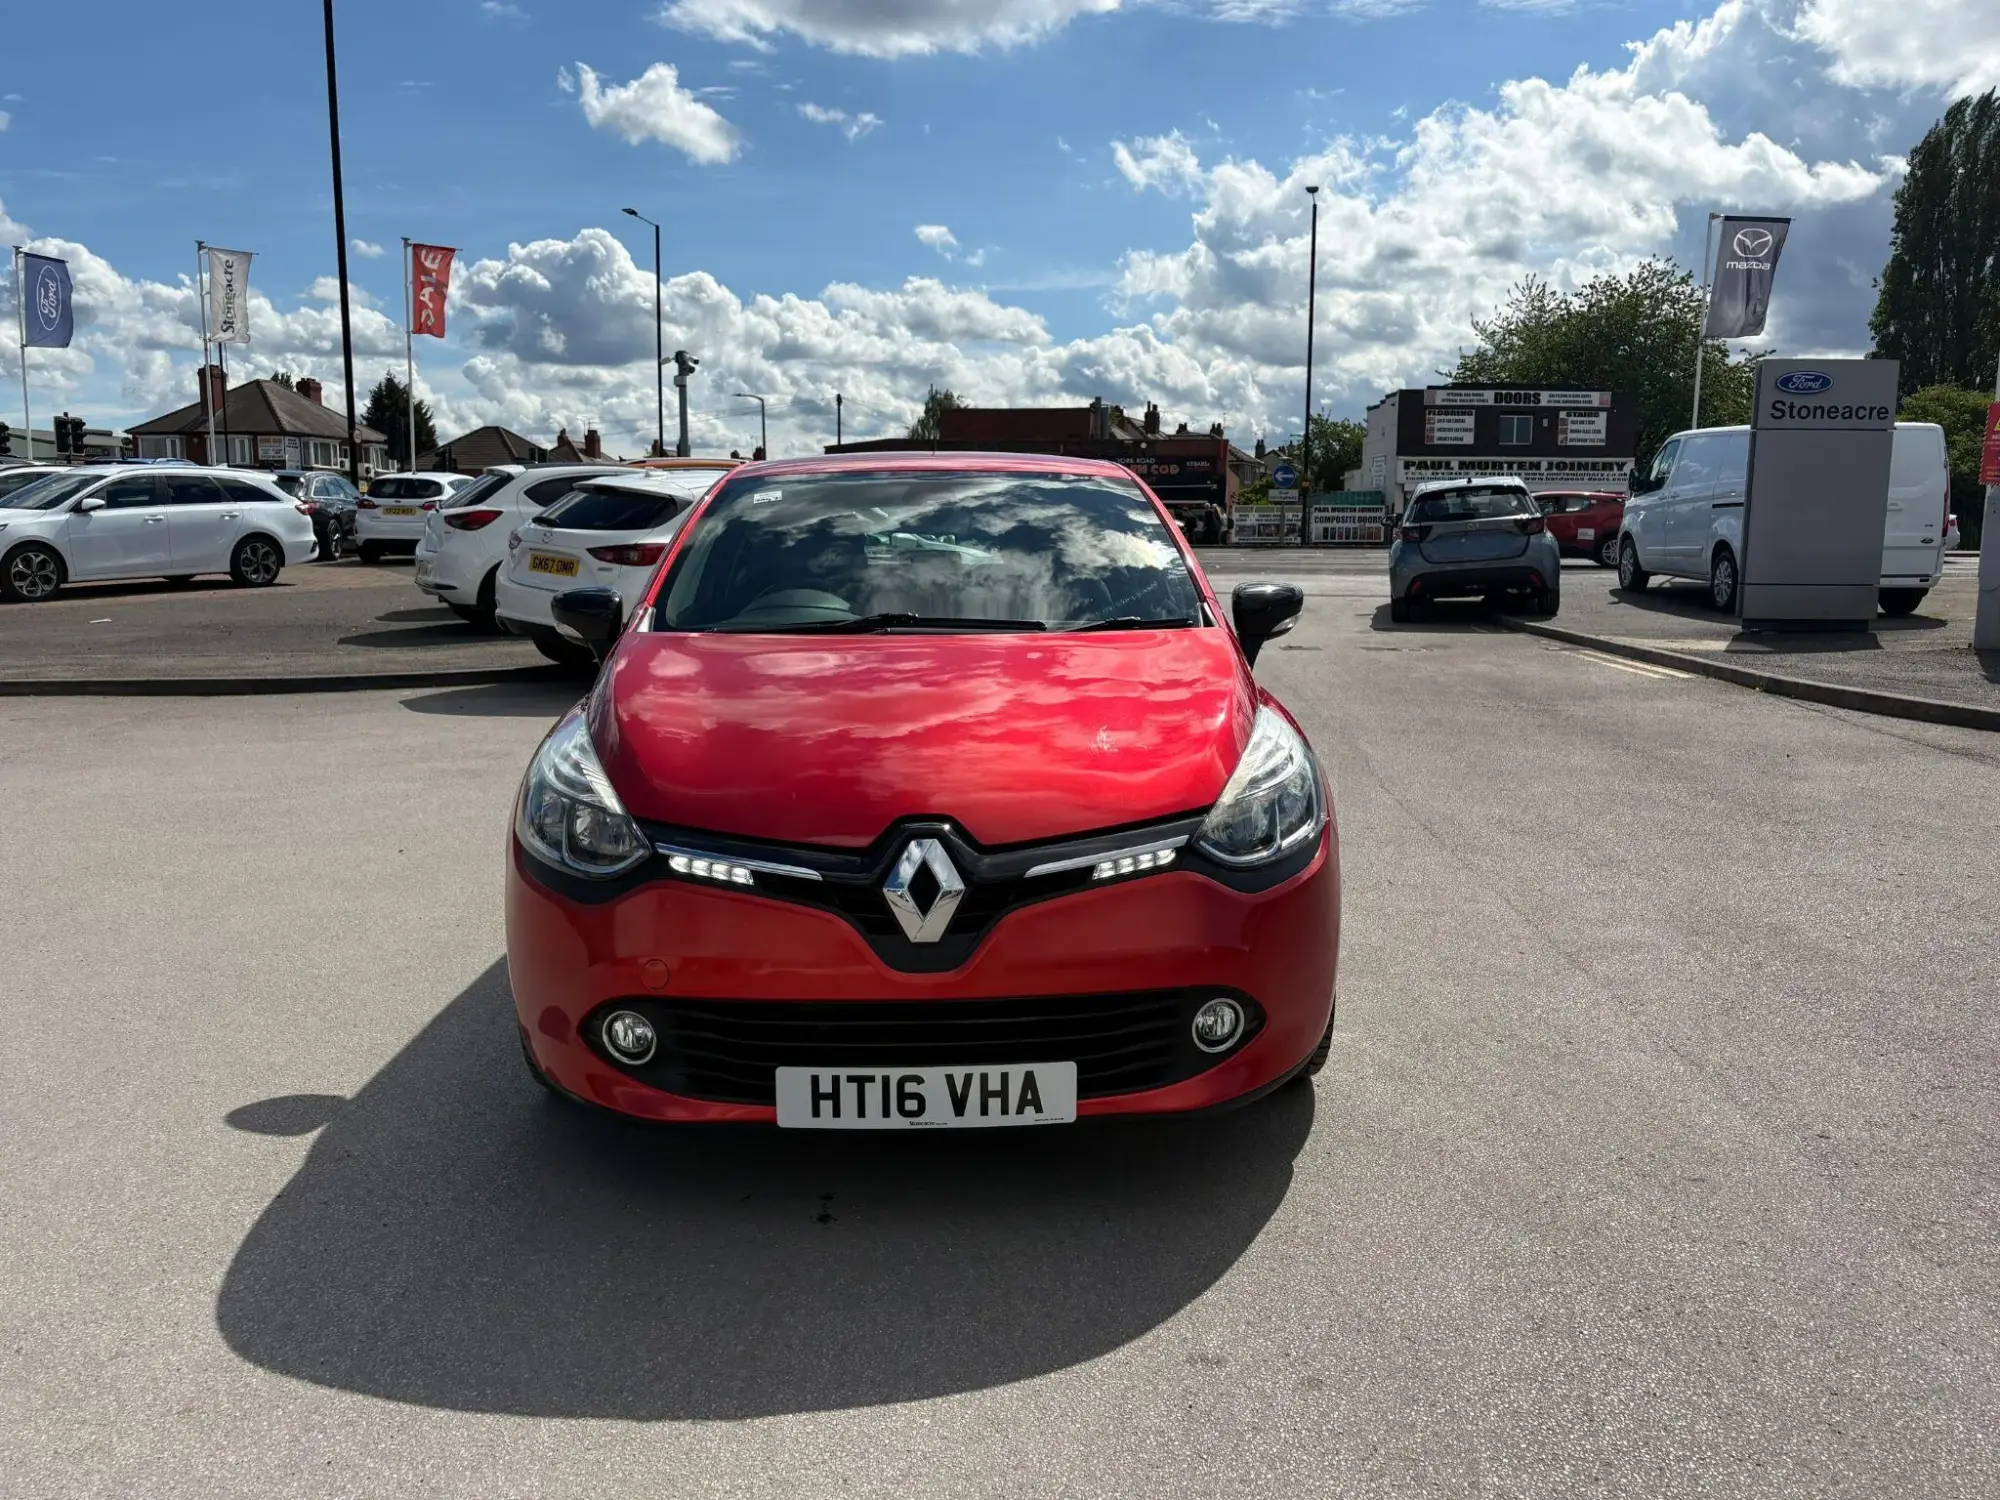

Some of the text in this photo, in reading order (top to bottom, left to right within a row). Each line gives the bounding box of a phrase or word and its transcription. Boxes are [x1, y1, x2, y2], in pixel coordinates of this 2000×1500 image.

[1726, 260, 1771, 271] mazda
[220, 258, 235, 334] Stoneacre
[420, 249, 443, 327] SALE
[39, 278, 58, 319] Ford
[1787, 374, 1824, 391] Ford
[1493, 391, 1542, 405] DOORS
[1427, 409, 1474, 417] FLOORING
[1770, 400, 1890, 422] Stoneacre
[1150, 464, 1180, 475] COD
[1403, 460, 1628, 472] PAUL MURTEN JOINERY
[1314, 515, 1383, 524] COMPOSITE DOORS
[532, 556, 556, 572] GK67
[810, 1070, 1044, 1119] HT16 VHA
